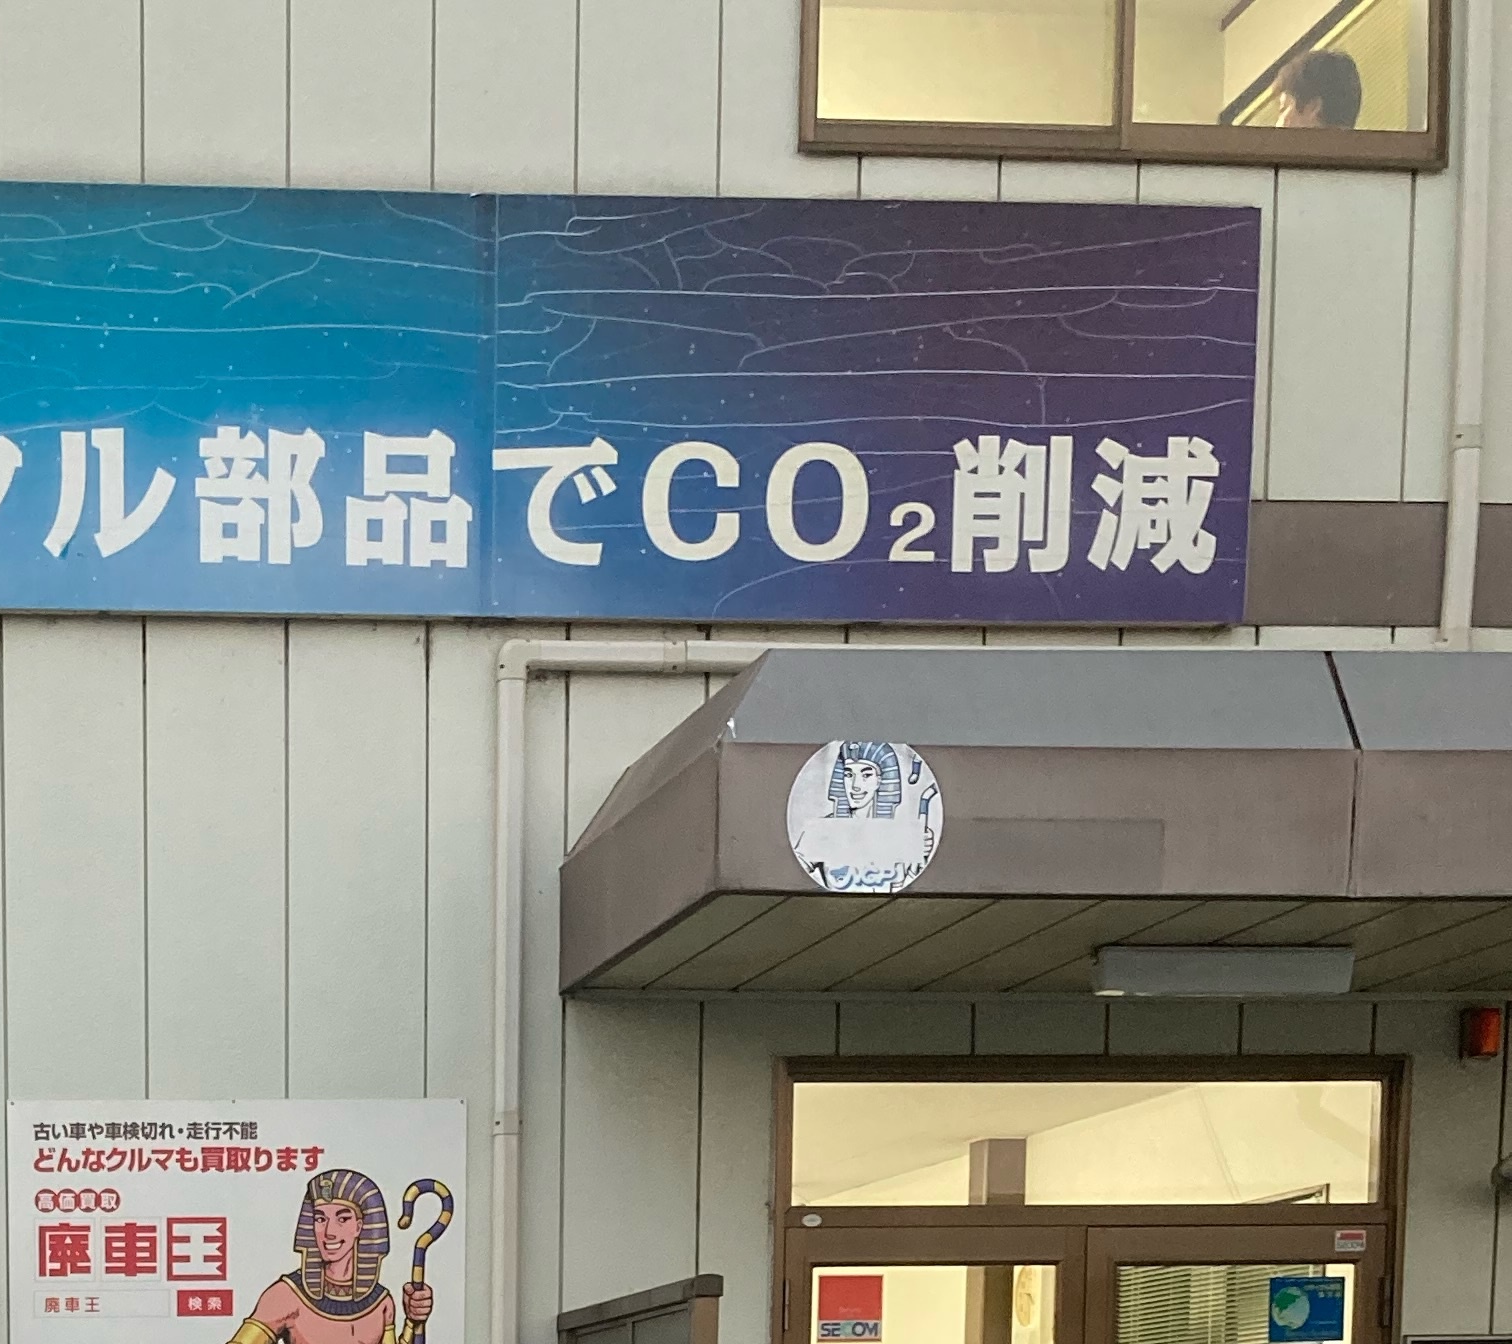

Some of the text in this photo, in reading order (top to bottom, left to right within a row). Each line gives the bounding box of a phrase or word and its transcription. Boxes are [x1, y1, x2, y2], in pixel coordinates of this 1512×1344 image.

[33, 1121, 258, 1142] 古い車や車検切れ・走行不能
[33, 1146, 325, 1174] どんなクルマも買取ります
[35, 1188, 121, 1213] 高価買取
[44, 1296, 101, 1314] 廃車王
[188, 1296, 223, 1312] 検索
[820, 1321, 879, 1338] SECOM
